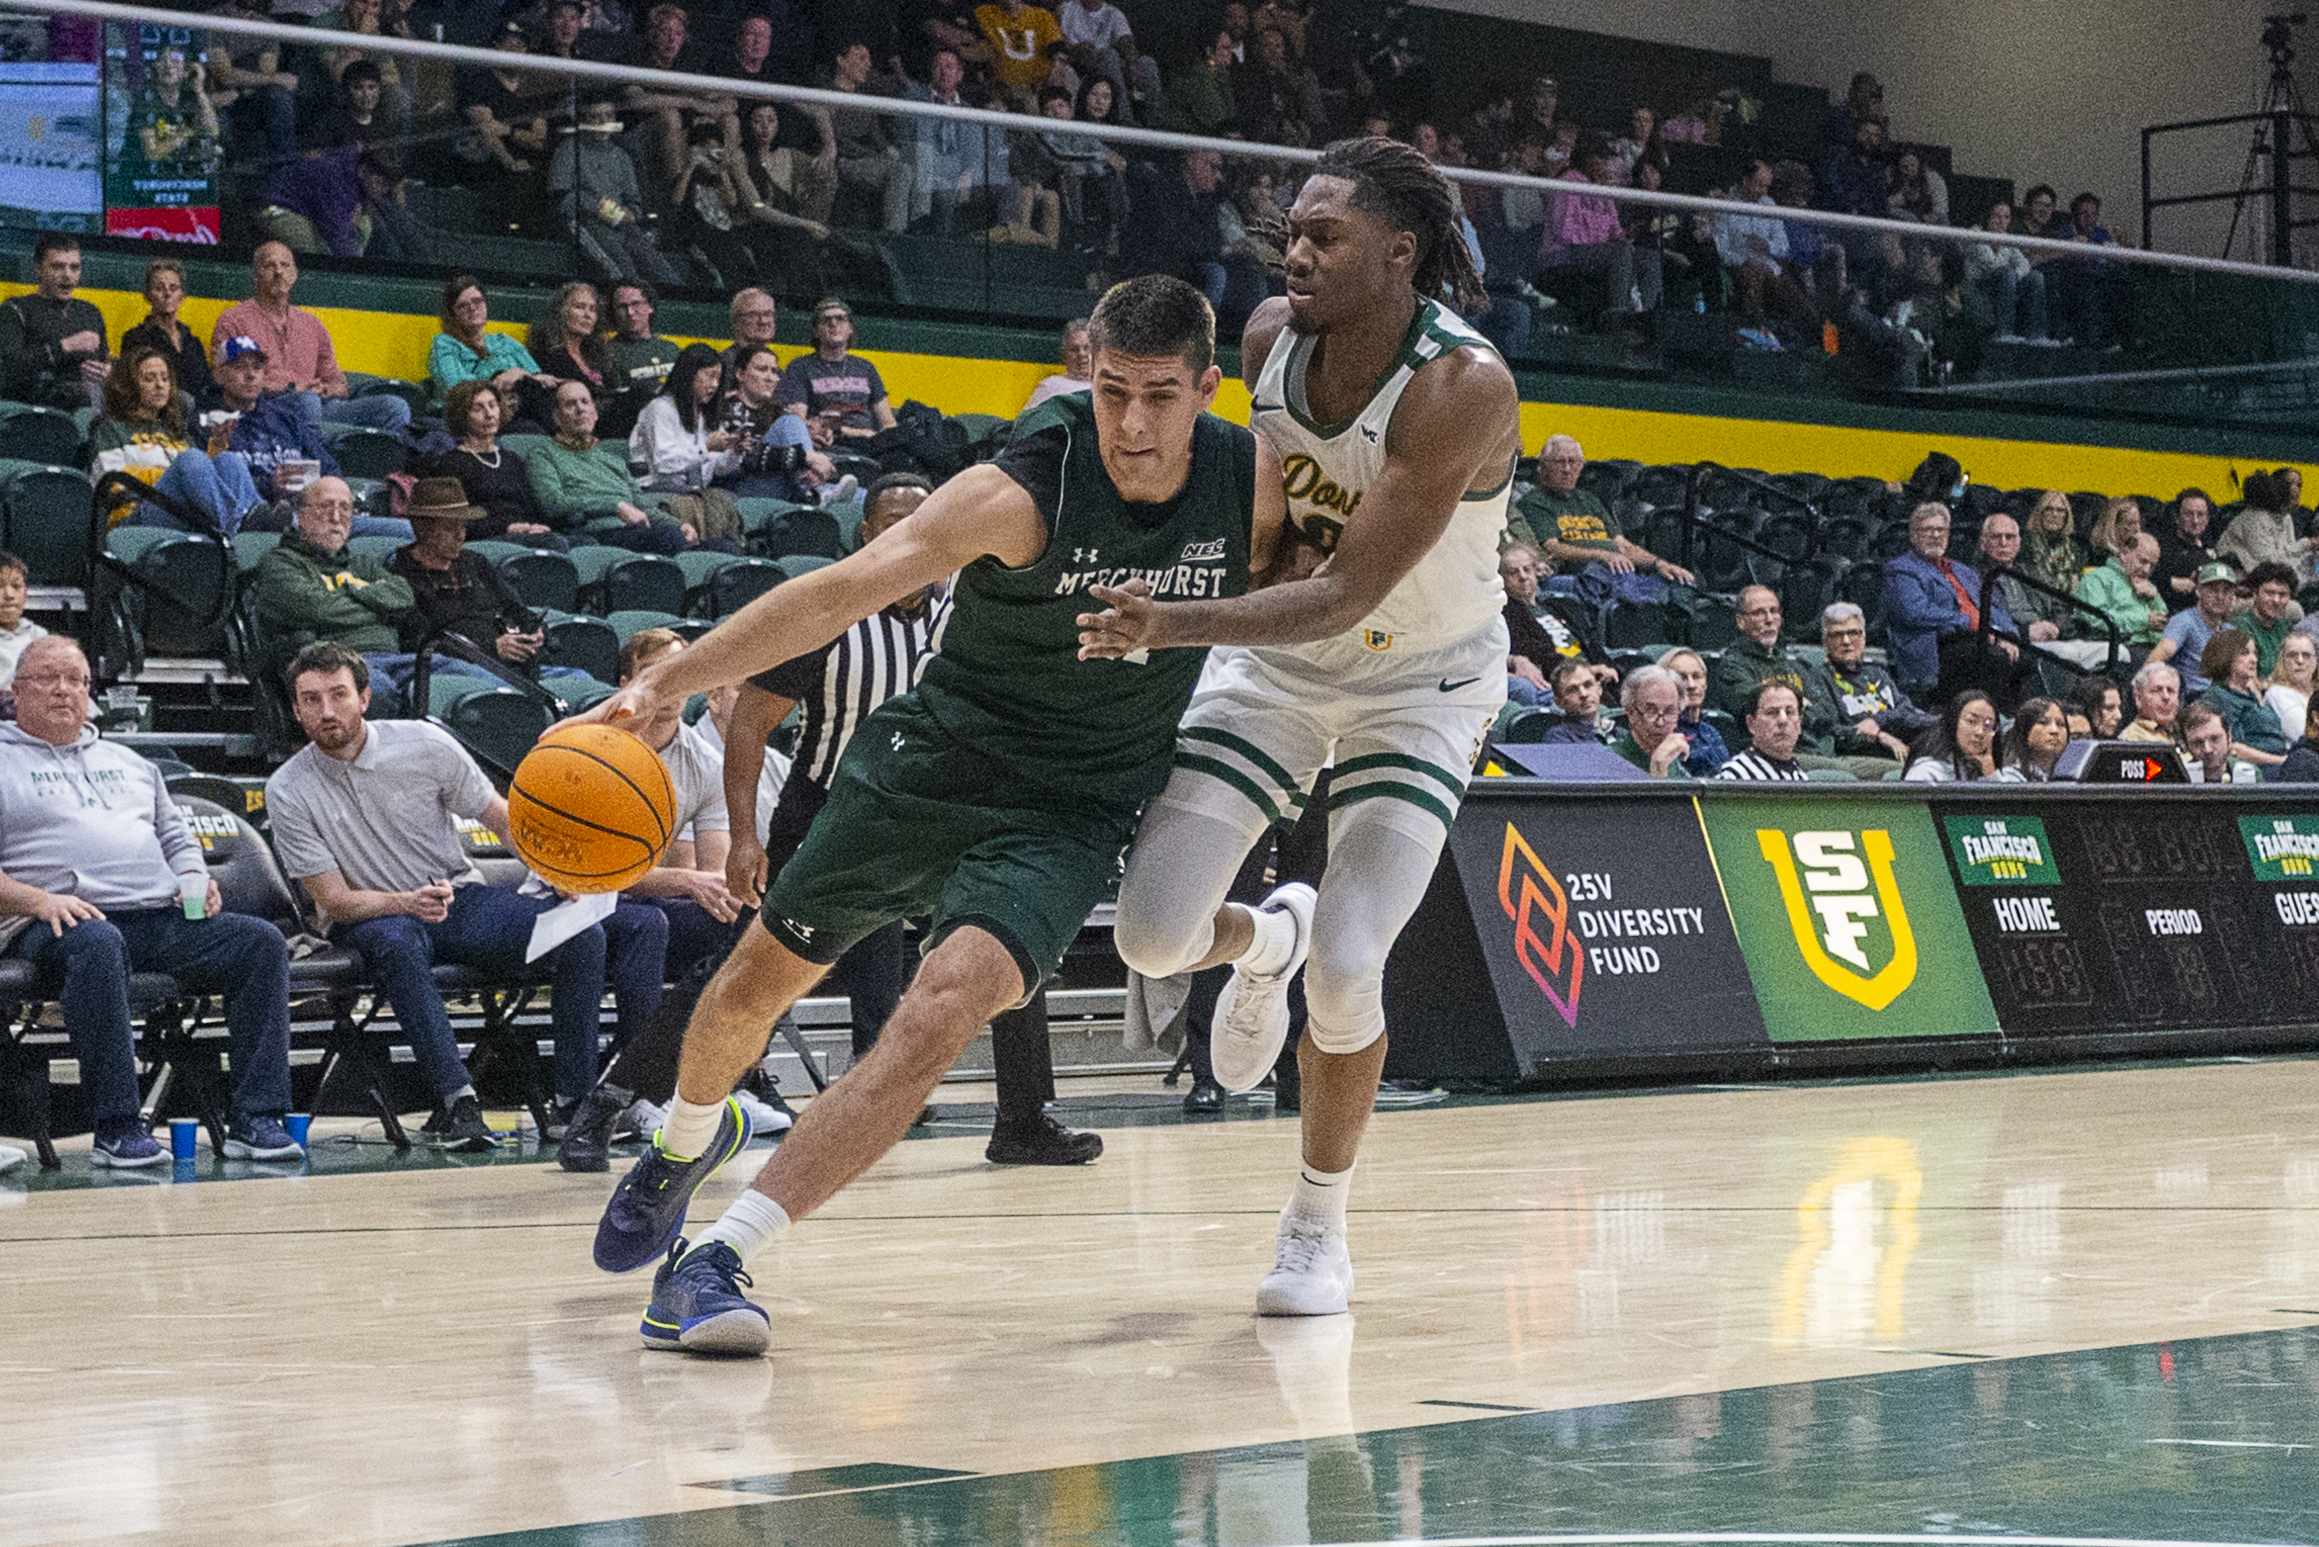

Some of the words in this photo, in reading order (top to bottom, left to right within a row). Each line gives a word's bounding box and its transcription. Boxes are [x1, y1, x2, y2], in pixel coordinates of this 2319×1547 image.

[1180, 537, 1226, 561] NEC
[2120, 759, 2144, 778] POSS
[1983, 820, 2007, 834] SAN
[2273, 820, 2294, 834] SAN
[1961, 834, 2043, 866] FRANCISCO
[1566, 874, 1612, 901] 25V
[1578, 908, 1705, 938] DIVERSITY
[1993, 897, 2061, 932] HOME
[2144, 909, 2202, 935] PERIOD
[1590, 947, 1660, 975] FUND
